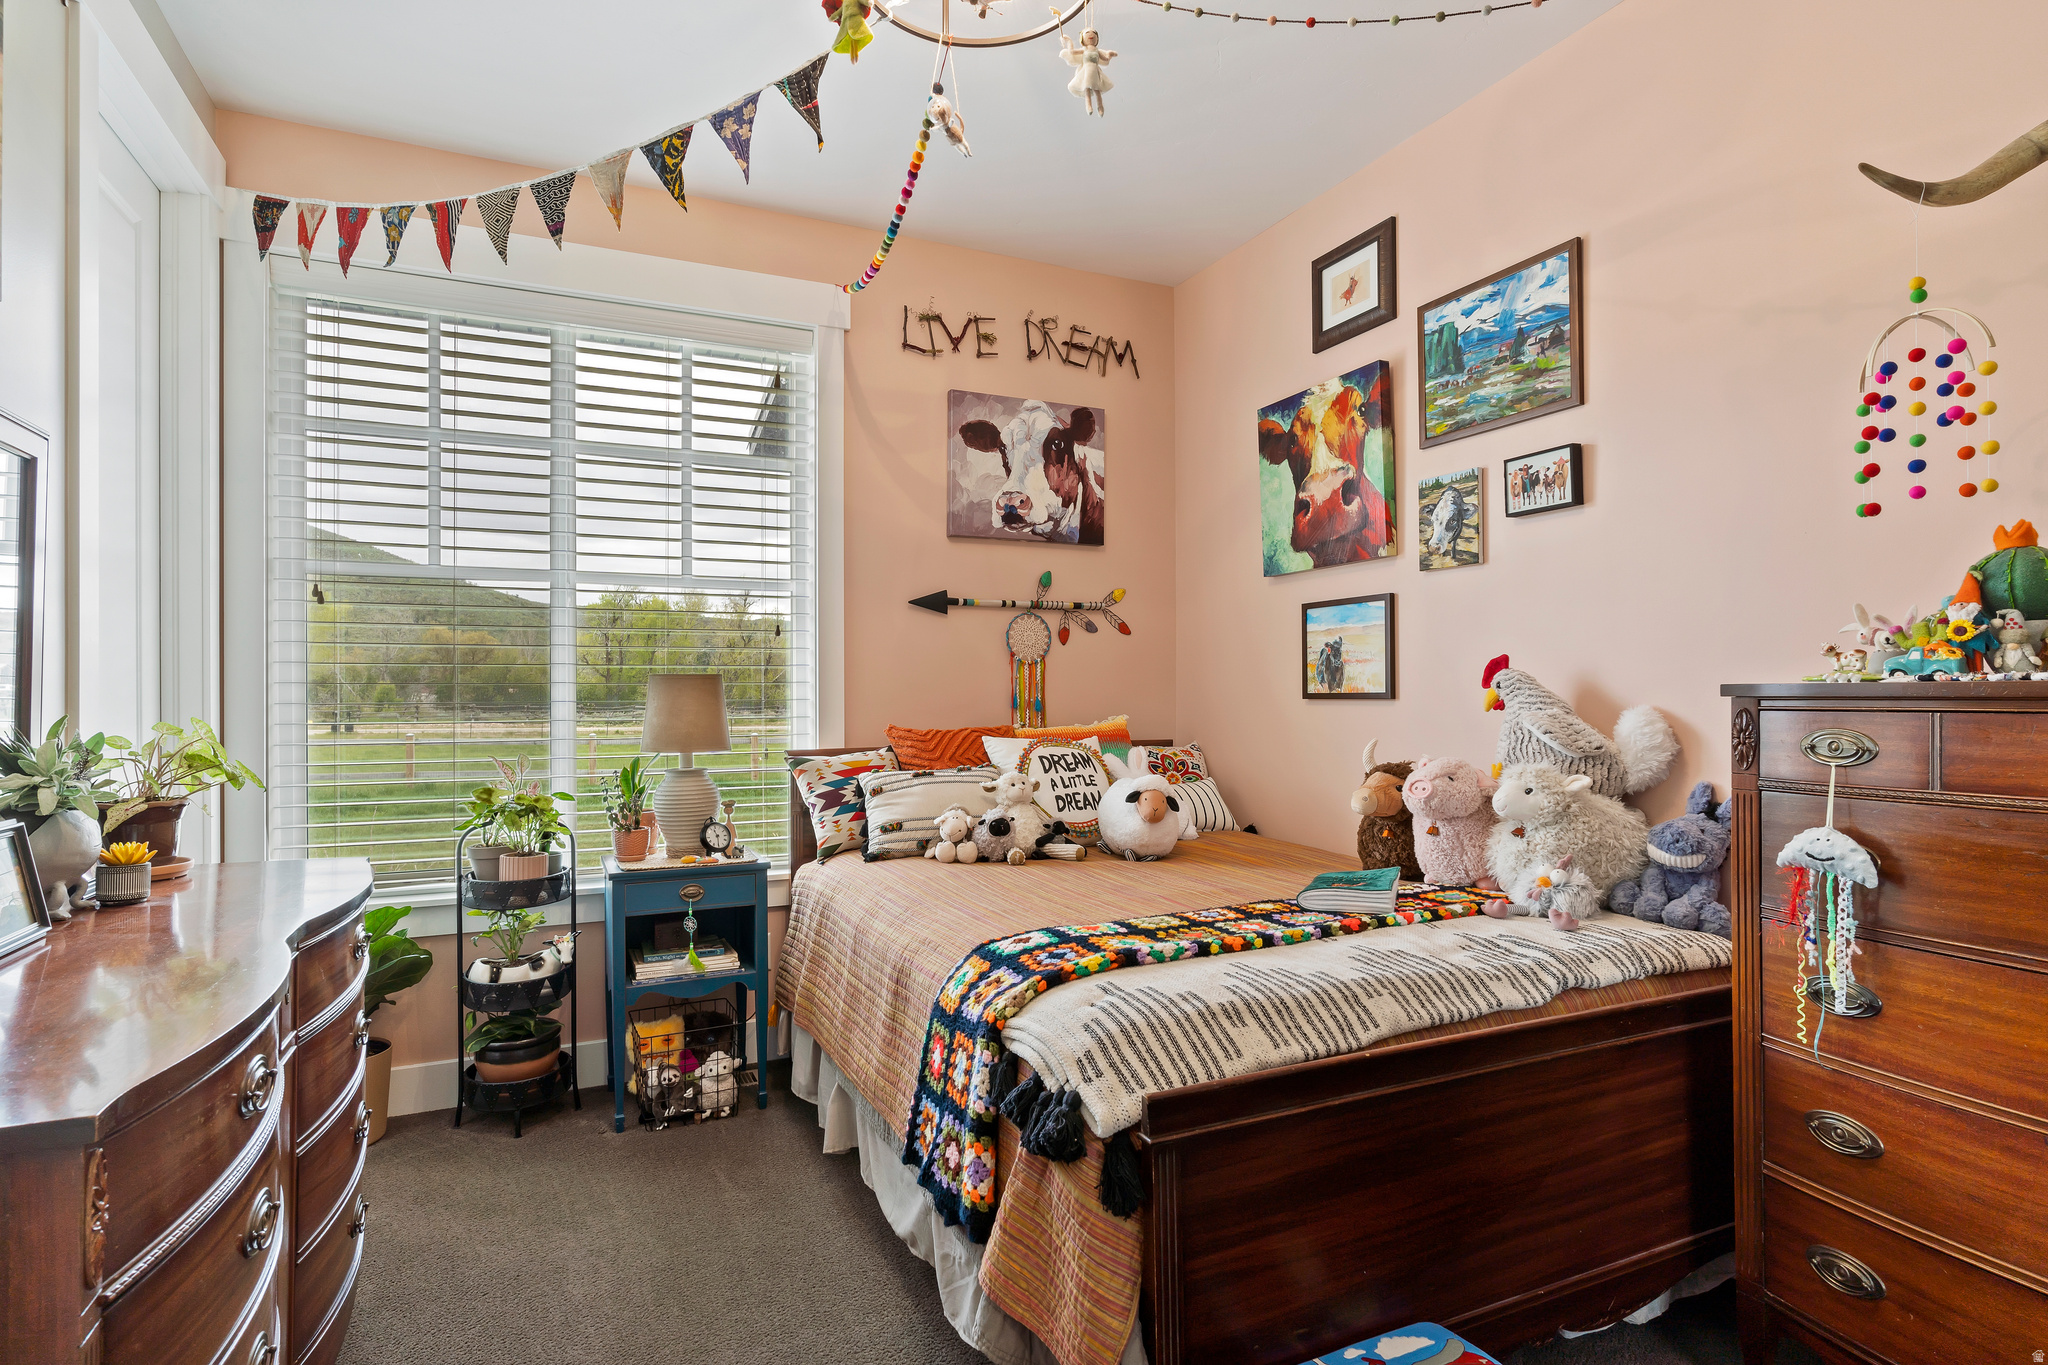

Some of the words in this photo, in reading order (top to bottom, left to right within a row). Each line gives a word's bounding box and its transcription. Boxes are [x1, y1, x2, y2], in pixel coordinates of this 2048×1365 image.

[901, 303, 999, 360] LIVE
[1024, 317, 1141, 380] DREAM
[1038, 752, 1098, 774] DREAM
[1050, 777, 1059, 792] A
[1059, 774, 1098, 789] LITTLE
